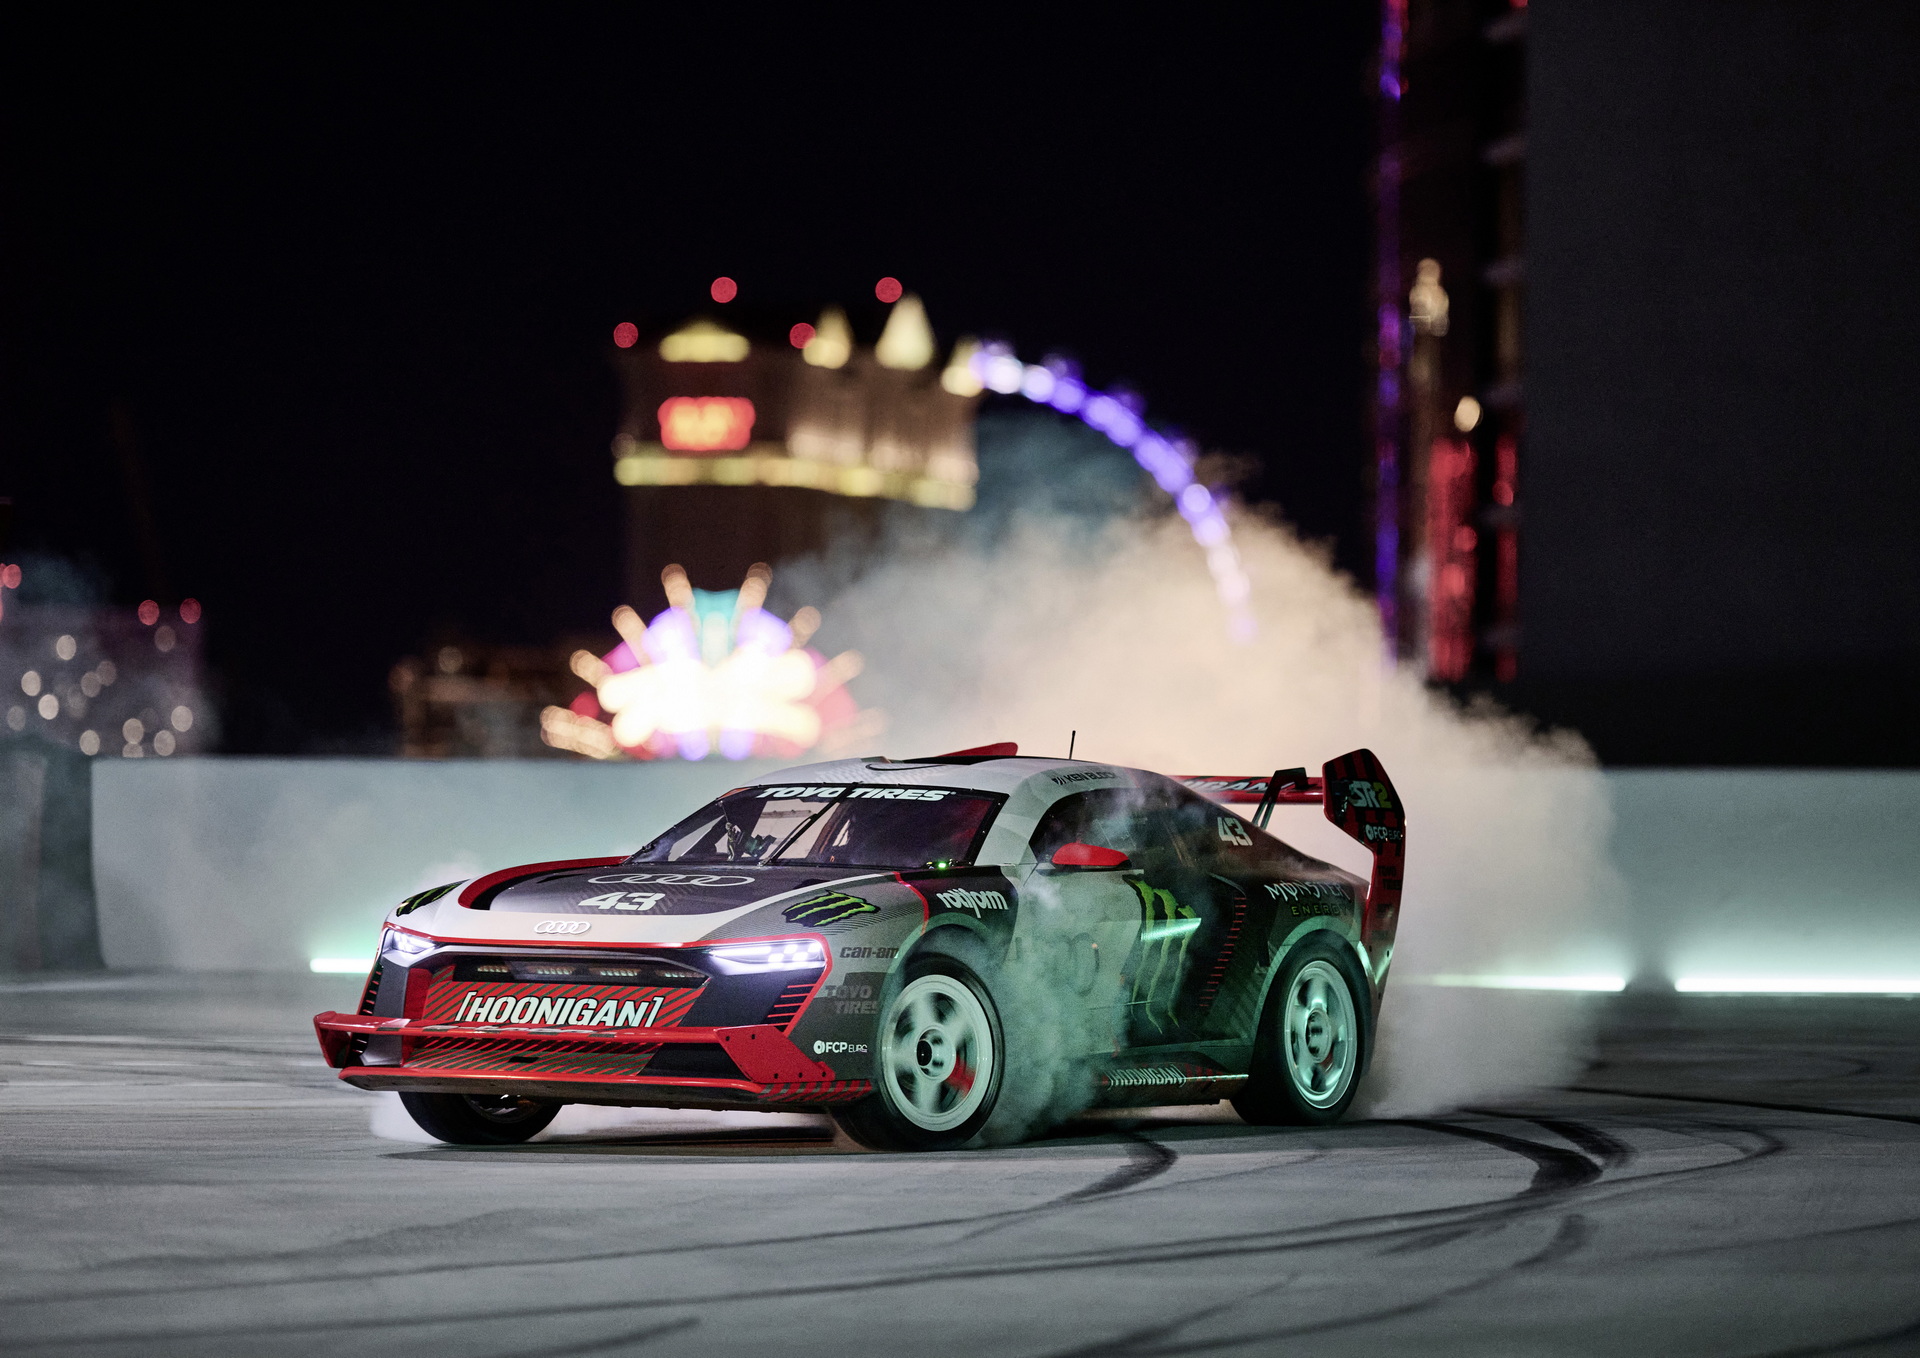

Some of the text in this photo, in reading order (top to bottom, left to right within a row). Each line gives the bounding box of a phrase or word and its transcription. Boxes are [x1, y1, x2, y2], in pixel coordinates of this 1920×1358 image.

[756, 786, 950, 801] TOYO TIRES
[1217, 816, 1253, 846] 43
[1373, 826, 1388, 839] FCP
[1263, 880, 1351, 901] MONSTER
[578, 891, 666, 911] 43
[936, 887, 1009, 919] rotiform
[839, 946, 900, 959] can-am
[454, 990, 664, 1027] [HOONIGAN]
[825, 1042, 848, 1053] FCP
